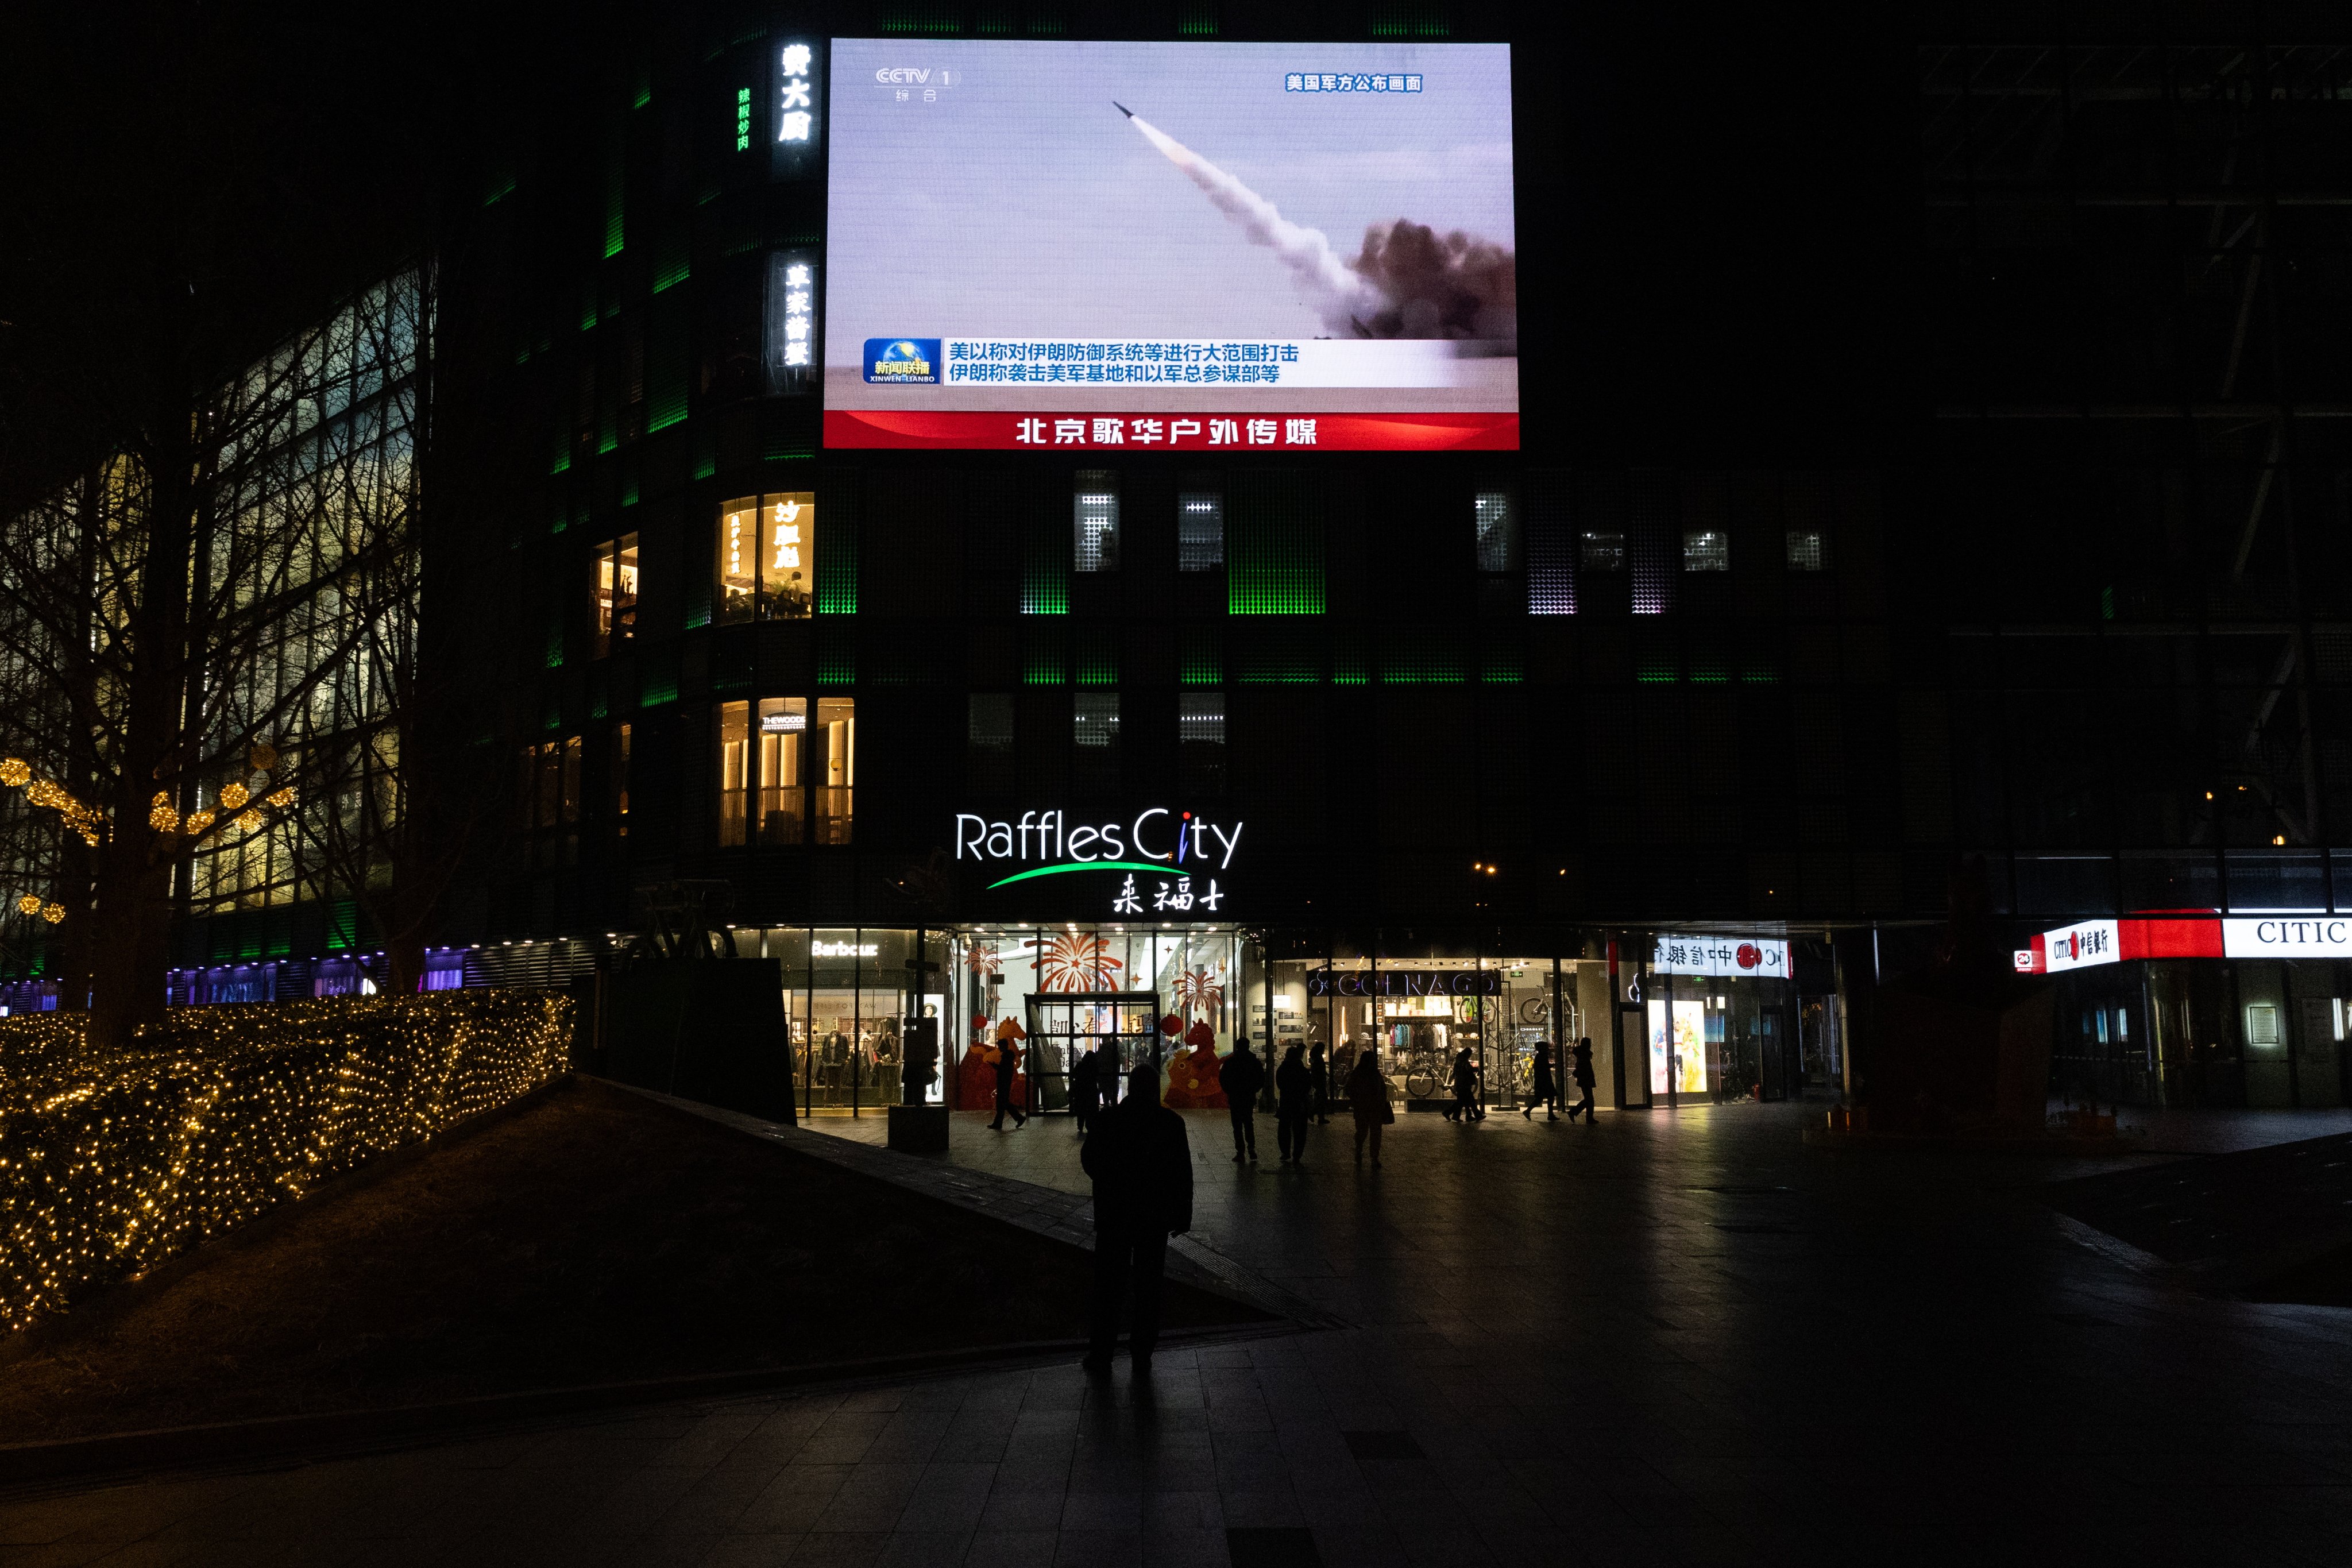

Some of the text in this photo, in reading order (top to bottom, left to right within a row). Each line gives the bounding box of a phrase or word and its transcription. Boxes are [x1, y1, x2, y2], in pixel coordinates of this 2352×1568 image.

[876, 68, 949, 86] CCTV 1
[1286, 74, 1422, 92] 美国军方公布画面
[896, 89, 936, 102] 综合
[738, 88, 750, 151] 辣椒炒肉
[949, 342, 1299, 362] 美以称对伊朗防御系统等进行大范围打击
[875, 360, 930, 376] 新闻联播
[949, 363, 1280, 383] 伊朗称袭击美军基地和以军总参谋部等
[1016, 418, 1318, 445] 北京歌华户外传媒
[956, 808, 1243, 869] Raffles City
[1113, 874, 1224, 914] 来福士
[2080, 928, 2108, 956] 中信银行
[2257, 921, 2347, 943] CITIC
